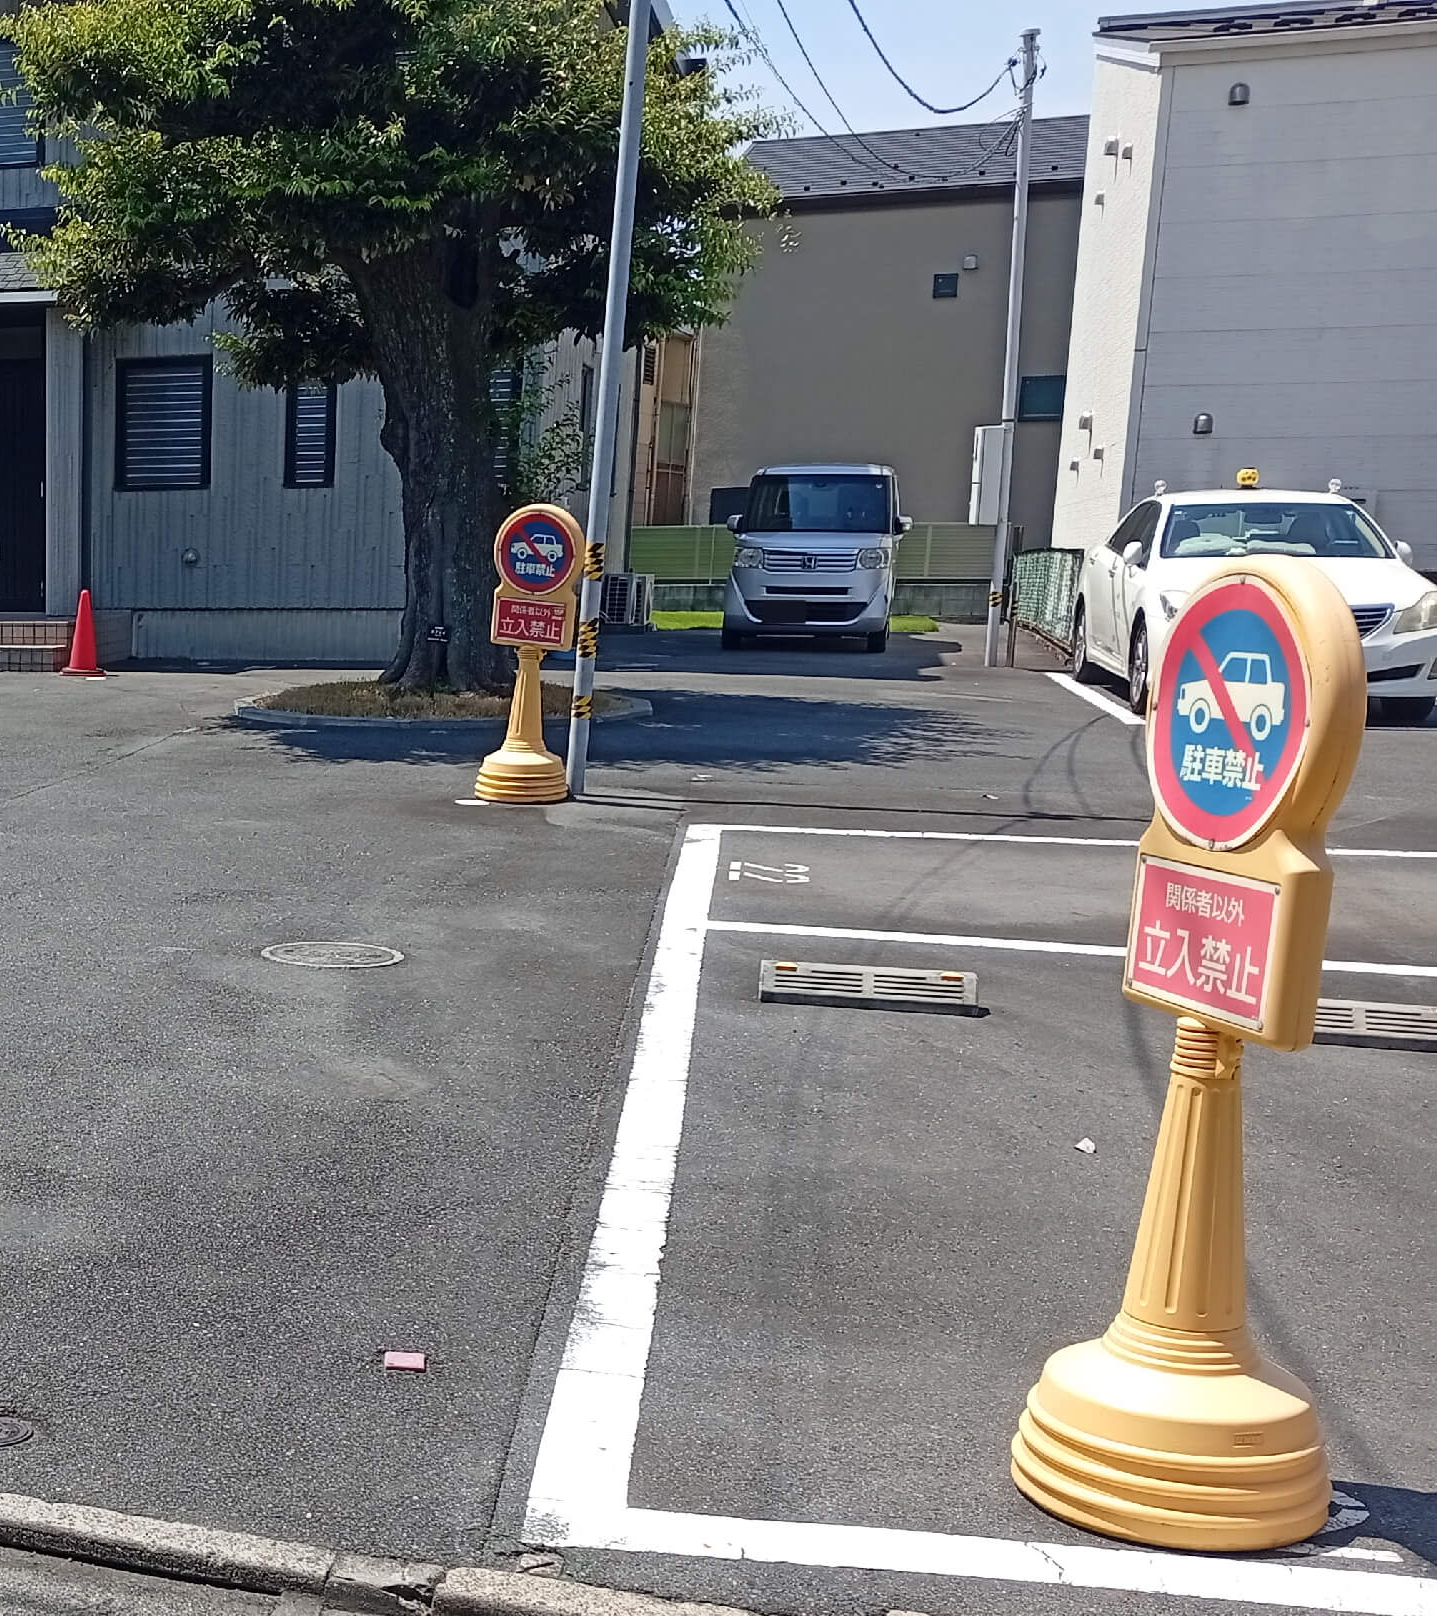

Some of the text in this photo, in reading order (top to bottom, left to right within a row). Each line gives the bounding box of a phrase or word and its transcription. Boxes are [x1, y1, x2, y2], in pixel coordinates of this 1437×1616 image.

[514, 561, 556, 578] 駐車禁止
[499, 616, 560, 641] 立入禁止
[1179, 743, 1265, 791] 駐車禁止
[1165, 881, 1245, 927] 関係者以外
[1138, 919, 1260, 1005] 立入禁止
